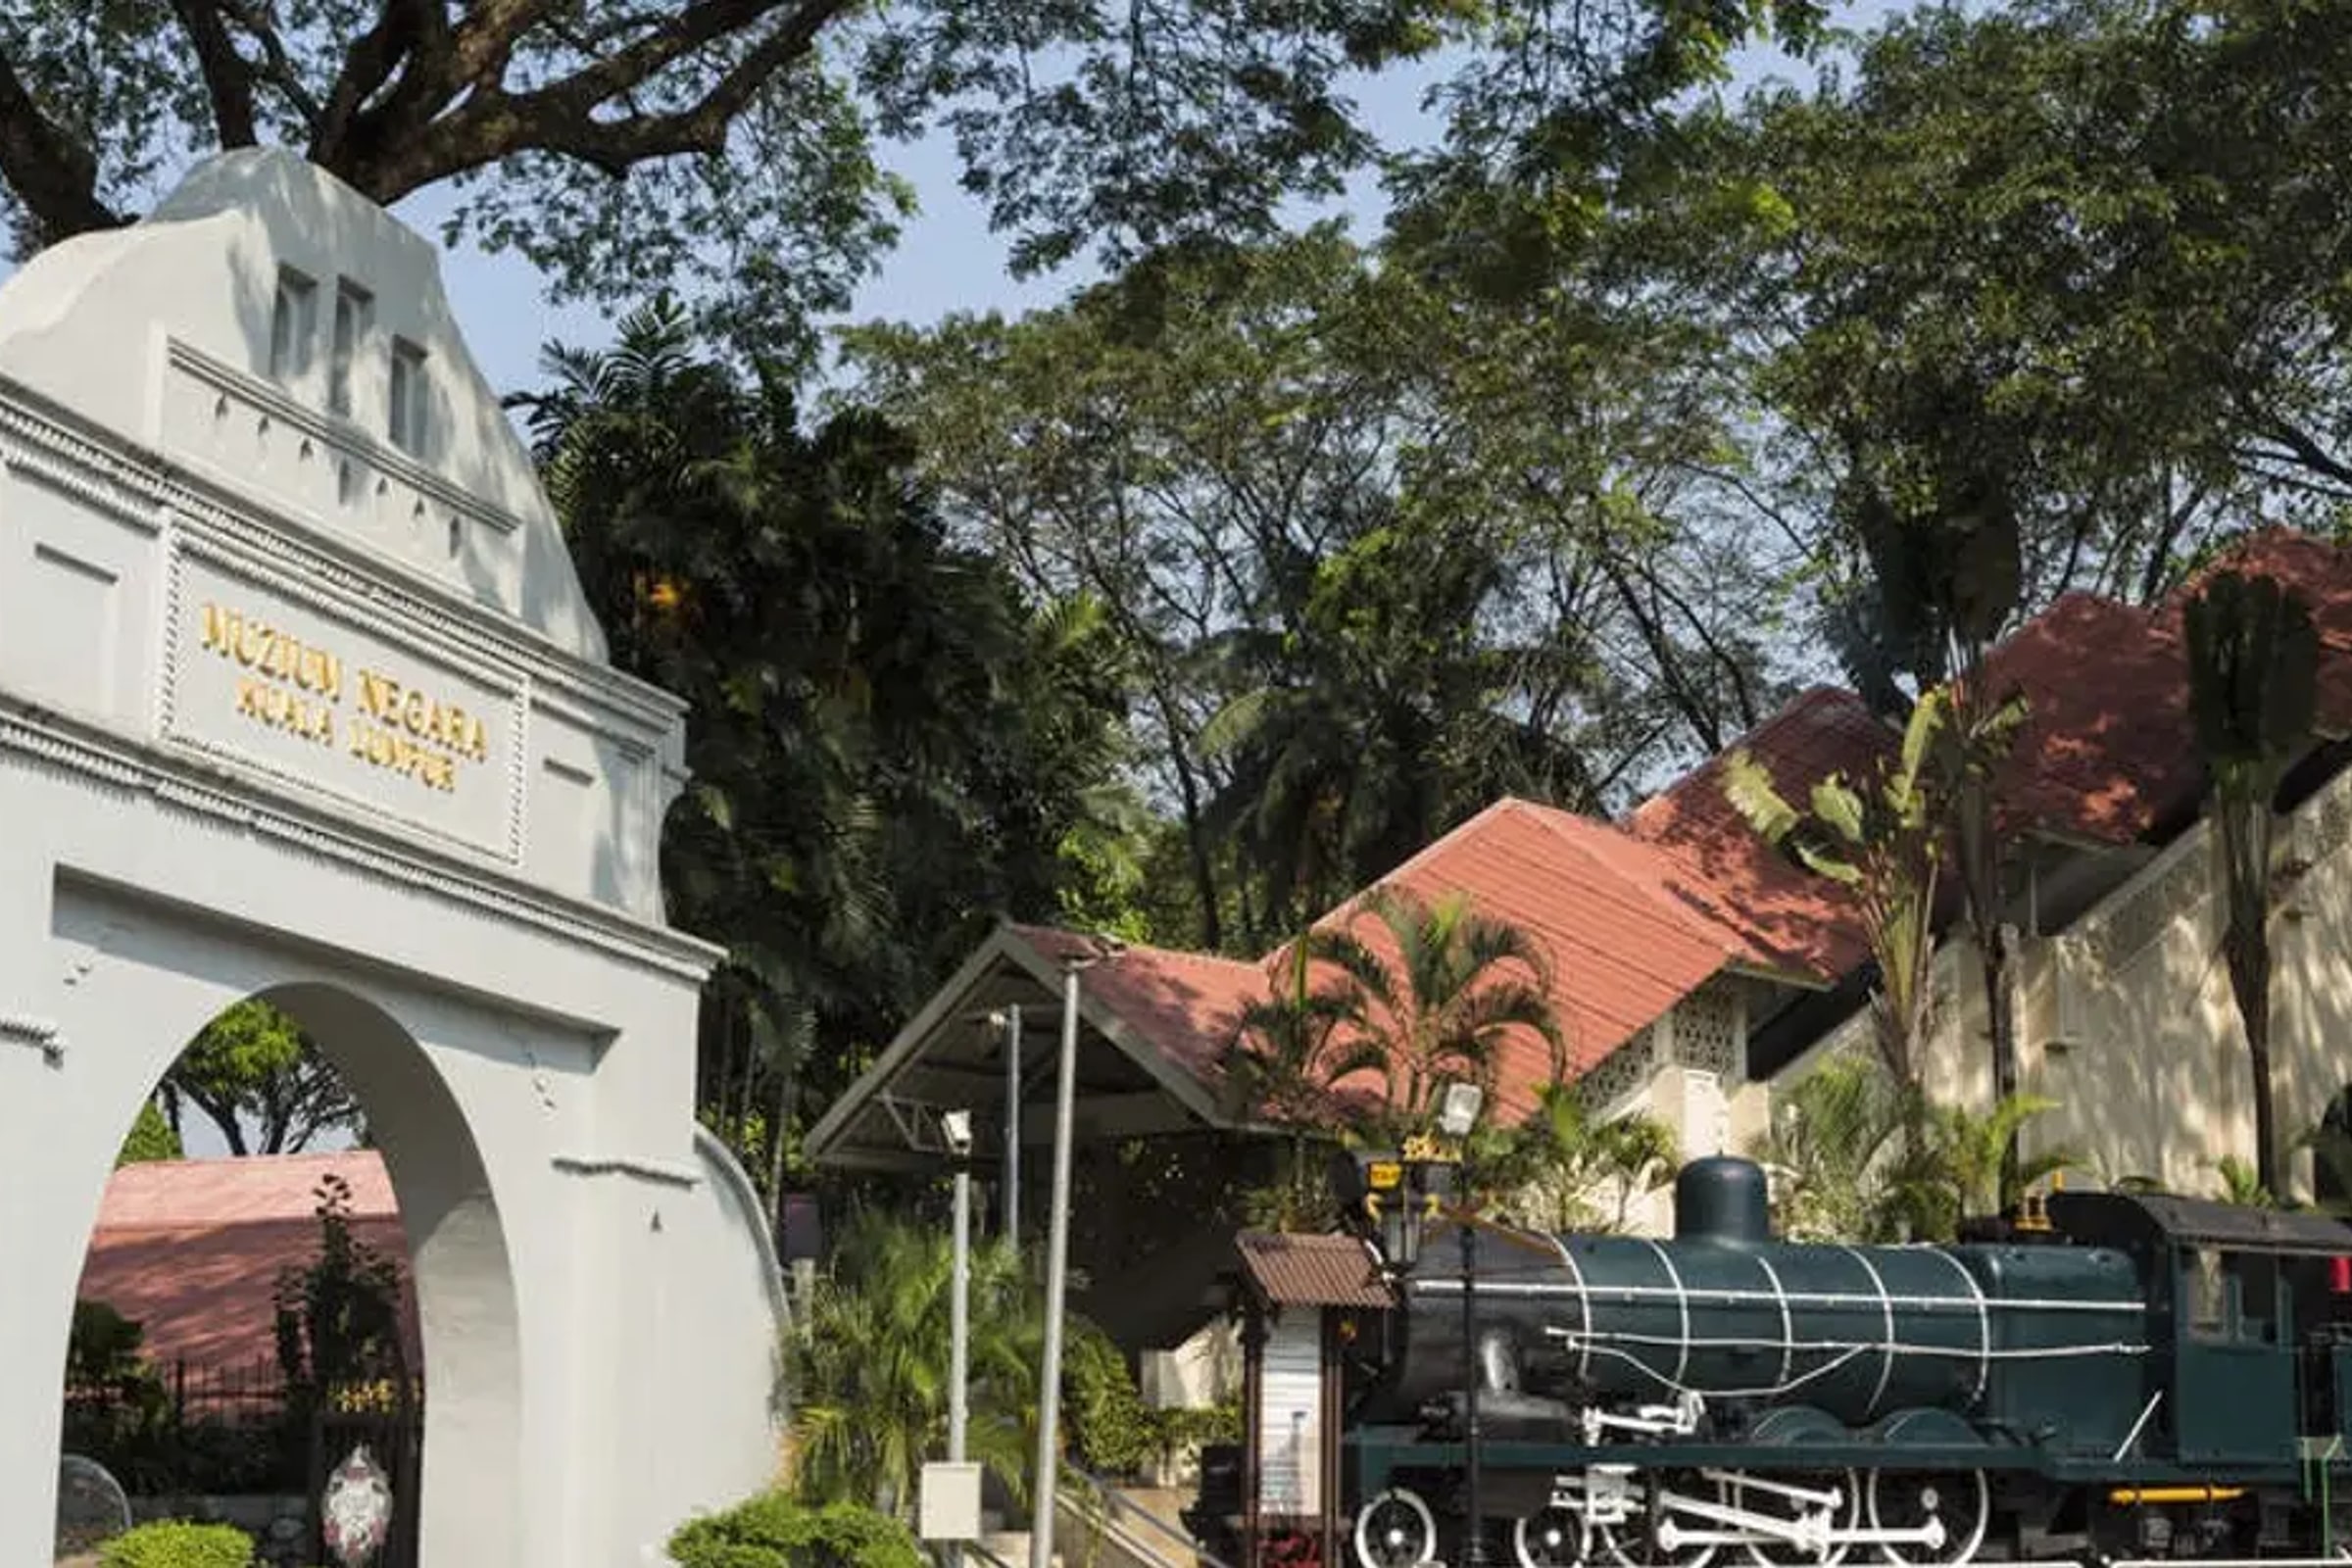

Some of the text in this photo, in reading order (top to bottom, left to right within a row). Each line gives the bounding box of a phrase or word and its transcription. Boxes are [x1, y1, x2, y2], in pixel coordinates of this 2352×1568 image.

[201, 602, 487, 762] MUZIUM NEGARA
[237, 678, 455, 793] KUALA LUMPUR
